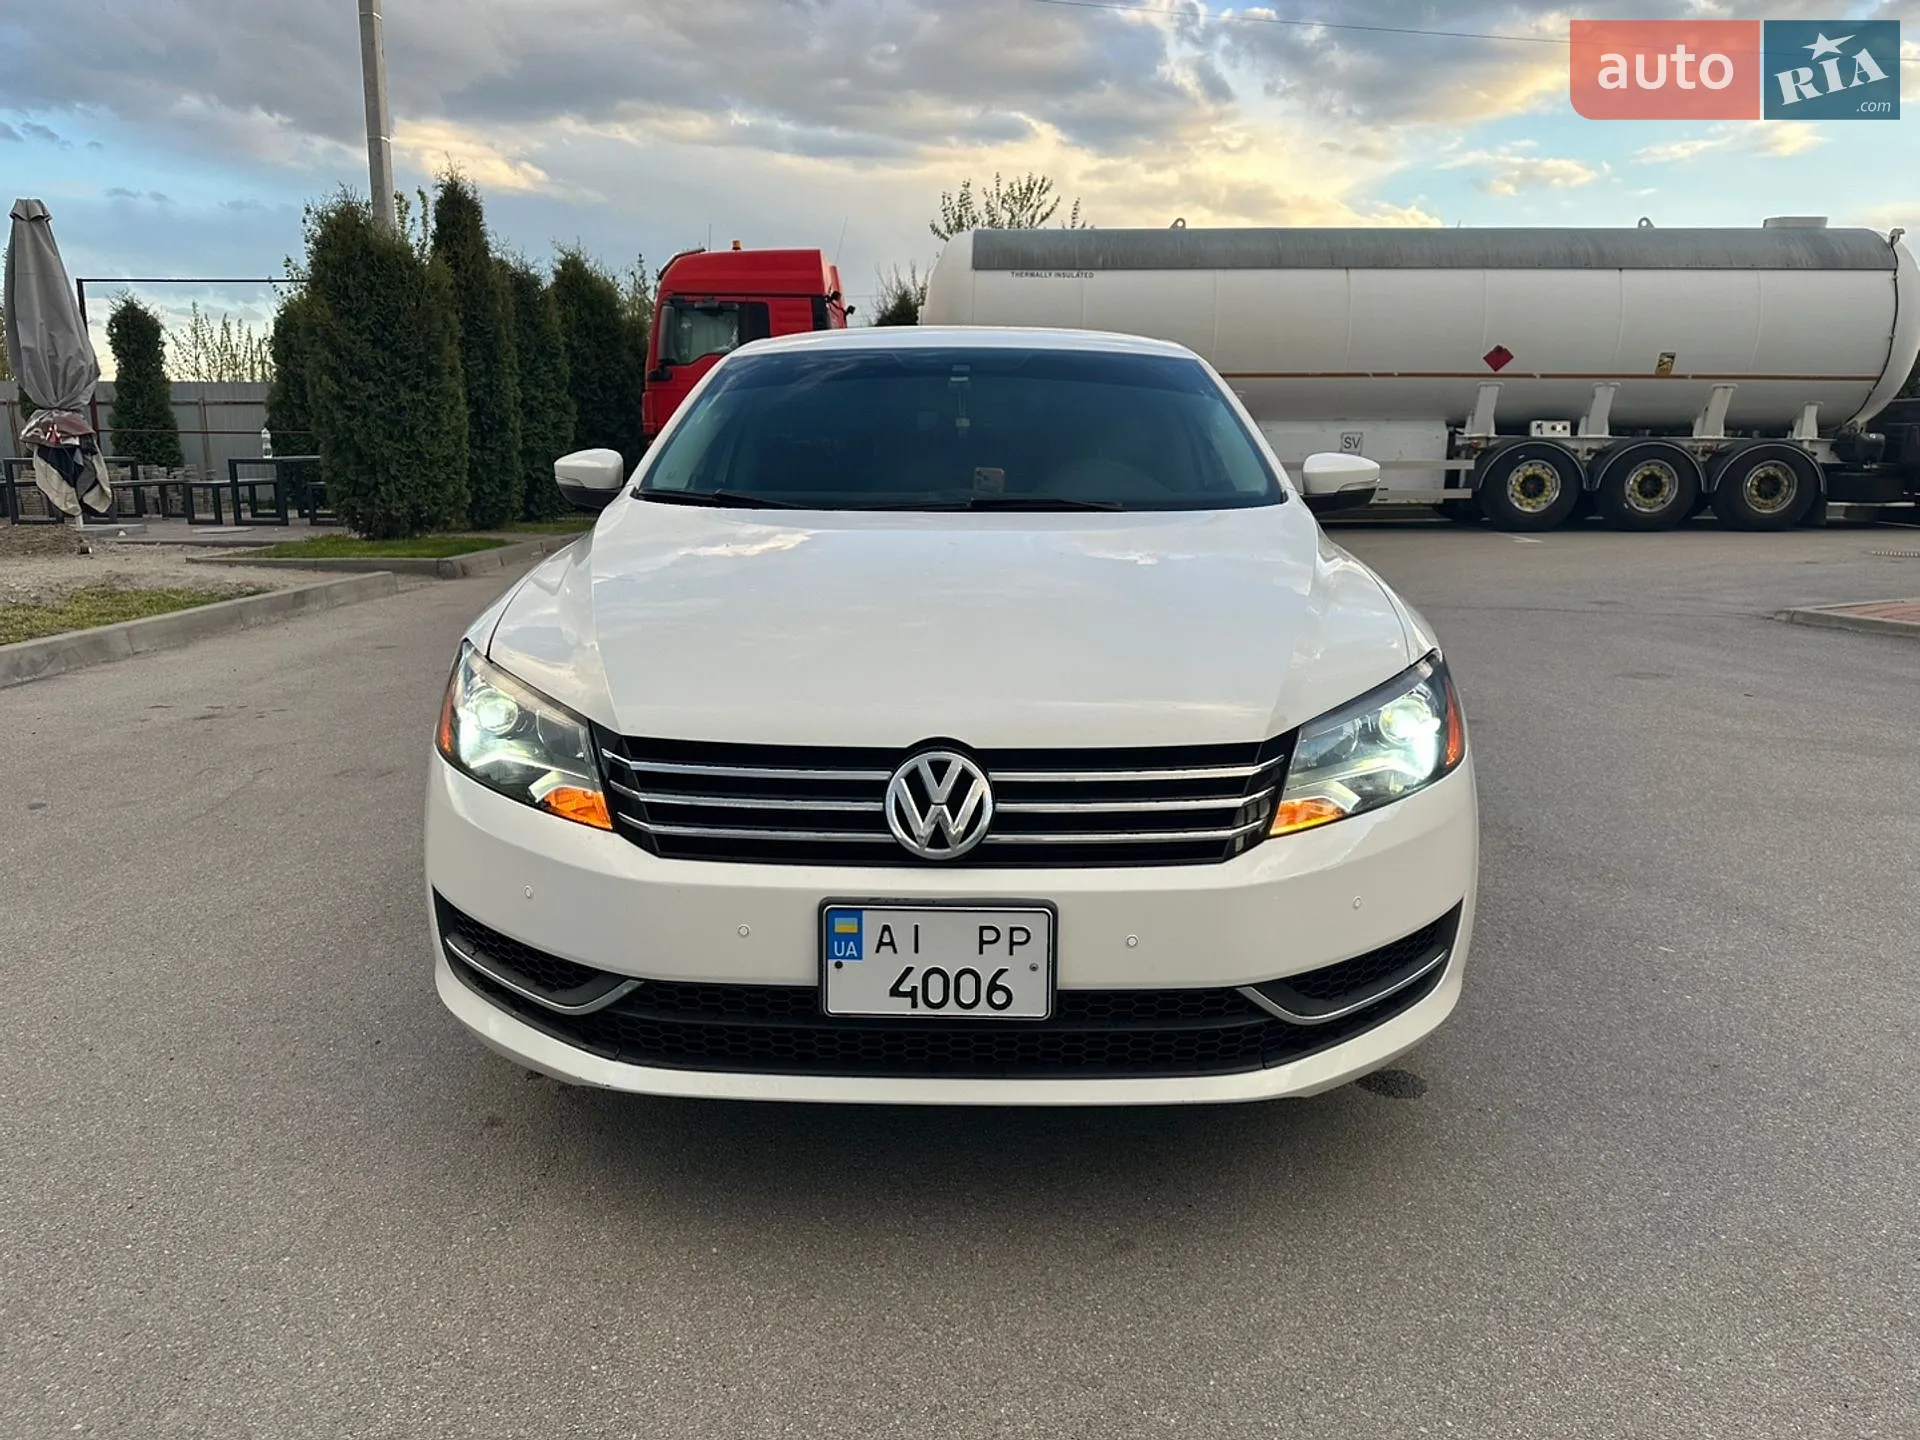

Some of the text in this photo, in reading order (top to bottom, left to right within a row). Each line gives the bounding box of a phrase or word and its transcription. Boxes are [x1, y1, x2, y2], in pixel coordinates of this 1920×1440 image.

[1010, 271, 1095, 279] THERMALLY INSULATED
[1343, 436, 1361, 449] SV
[875, 924, 1032, 956] AI PP
[834, 941, 858, 957] UA
[889, 966, 1013, 1011] 4006
